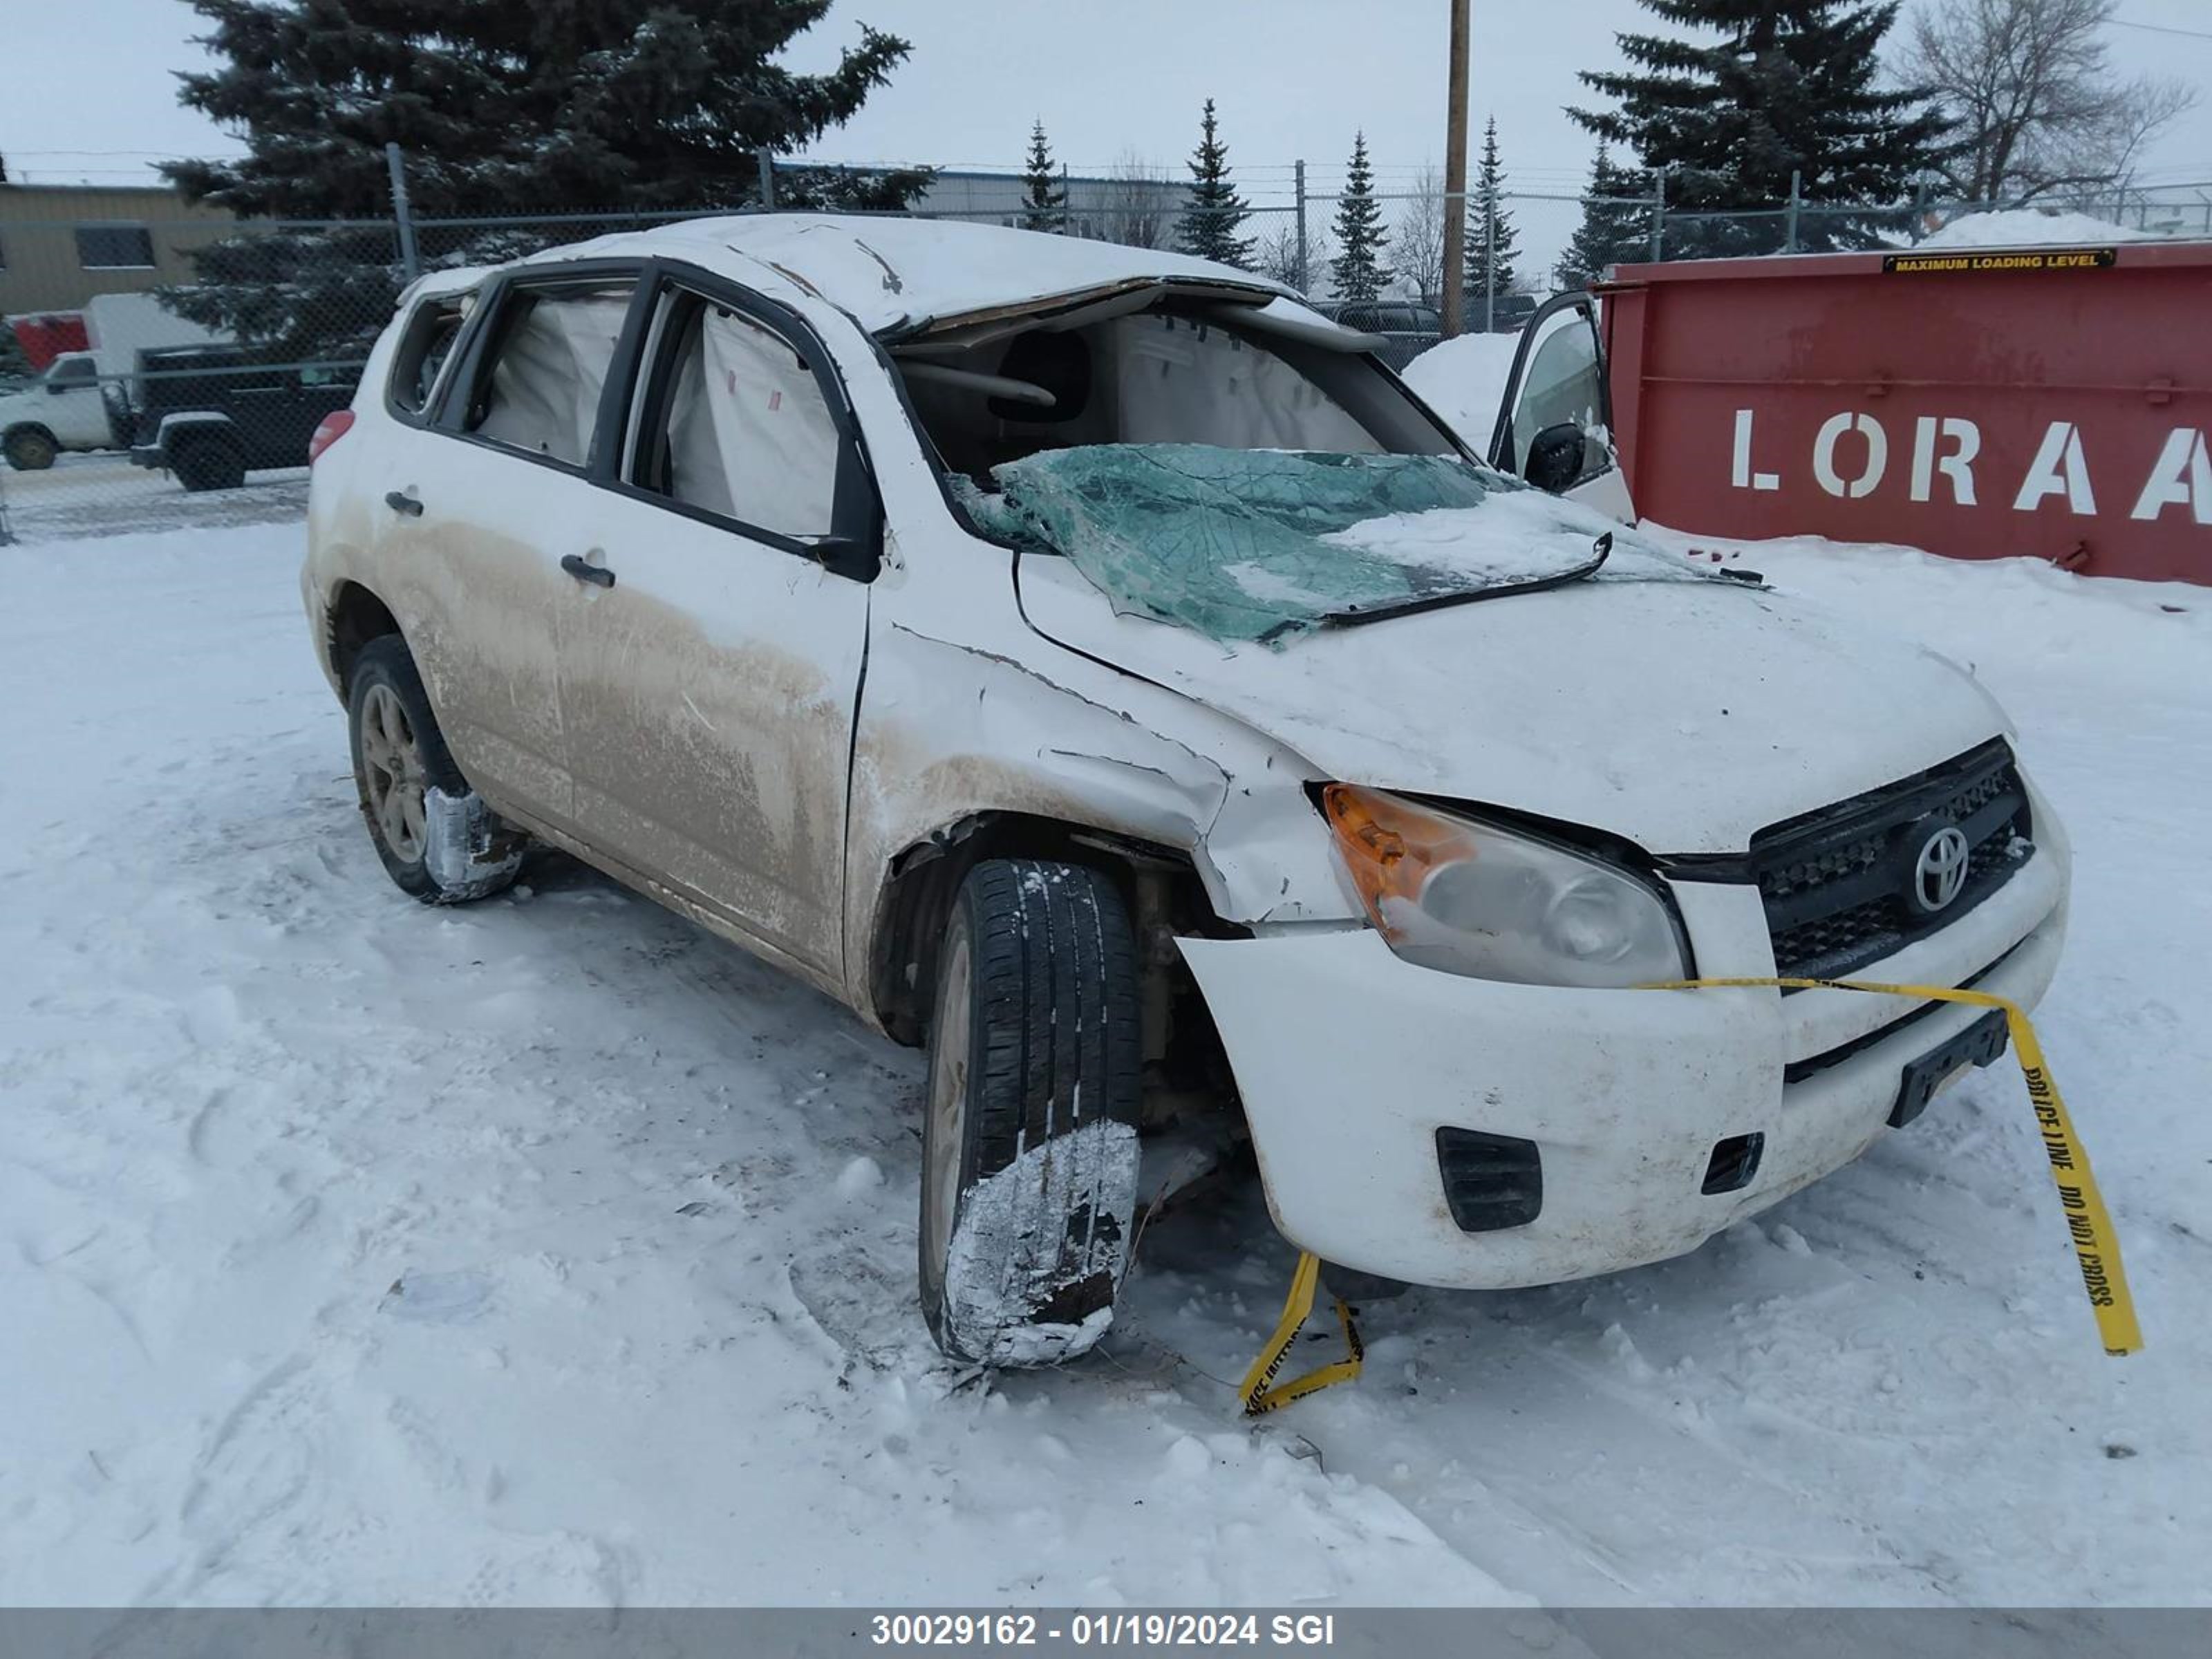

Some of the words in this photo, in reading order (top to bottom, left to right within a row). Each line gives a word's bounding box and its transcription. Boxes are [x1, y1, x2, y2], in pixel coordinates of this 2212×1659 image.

[1895, 259, 1969, 271] MAXIMUM
[1972, 256, 2043, 269] LOADING
[2046, 254, 2099, 267] LEVEL
